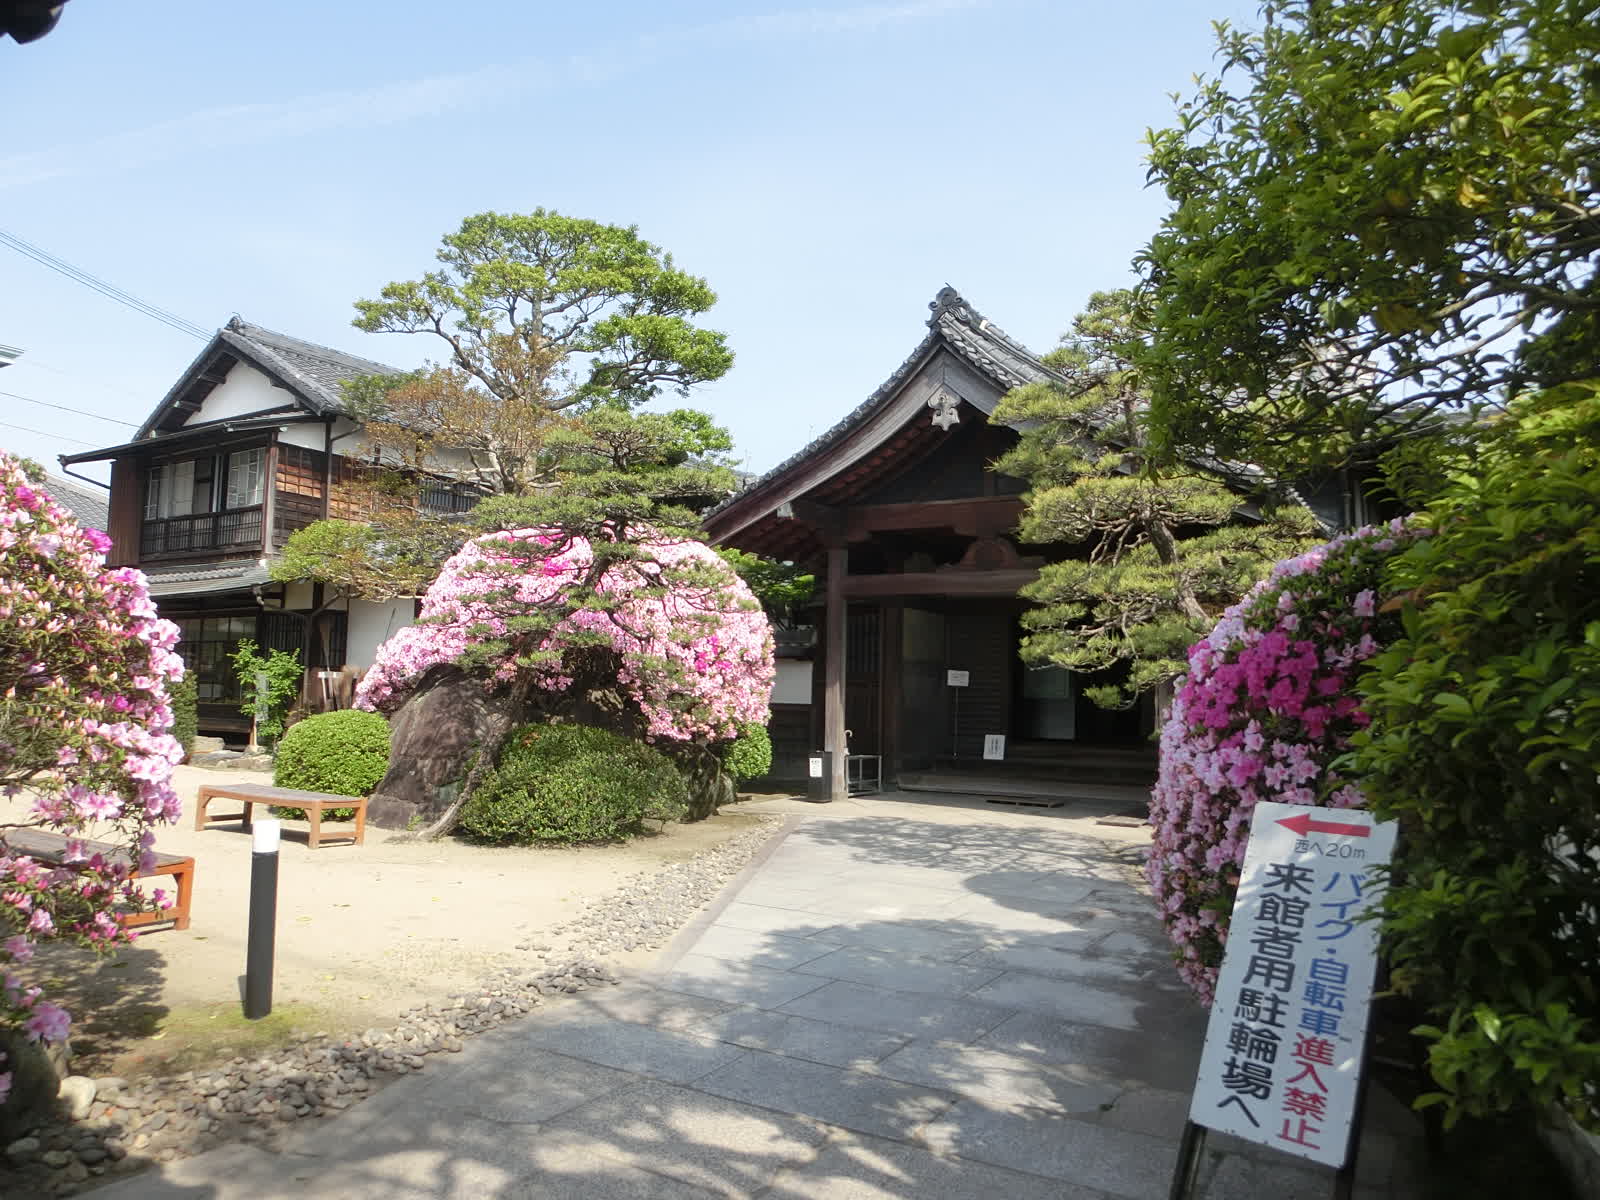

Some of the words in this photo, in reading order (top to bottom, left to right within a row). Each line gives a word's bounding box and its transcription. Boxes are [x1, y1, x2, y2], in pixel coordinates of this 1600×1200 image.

[1294, 838, 1366, 859] 西へ20m
[1217, 863, 1315, 1128] 来館者用駐輪場へ
